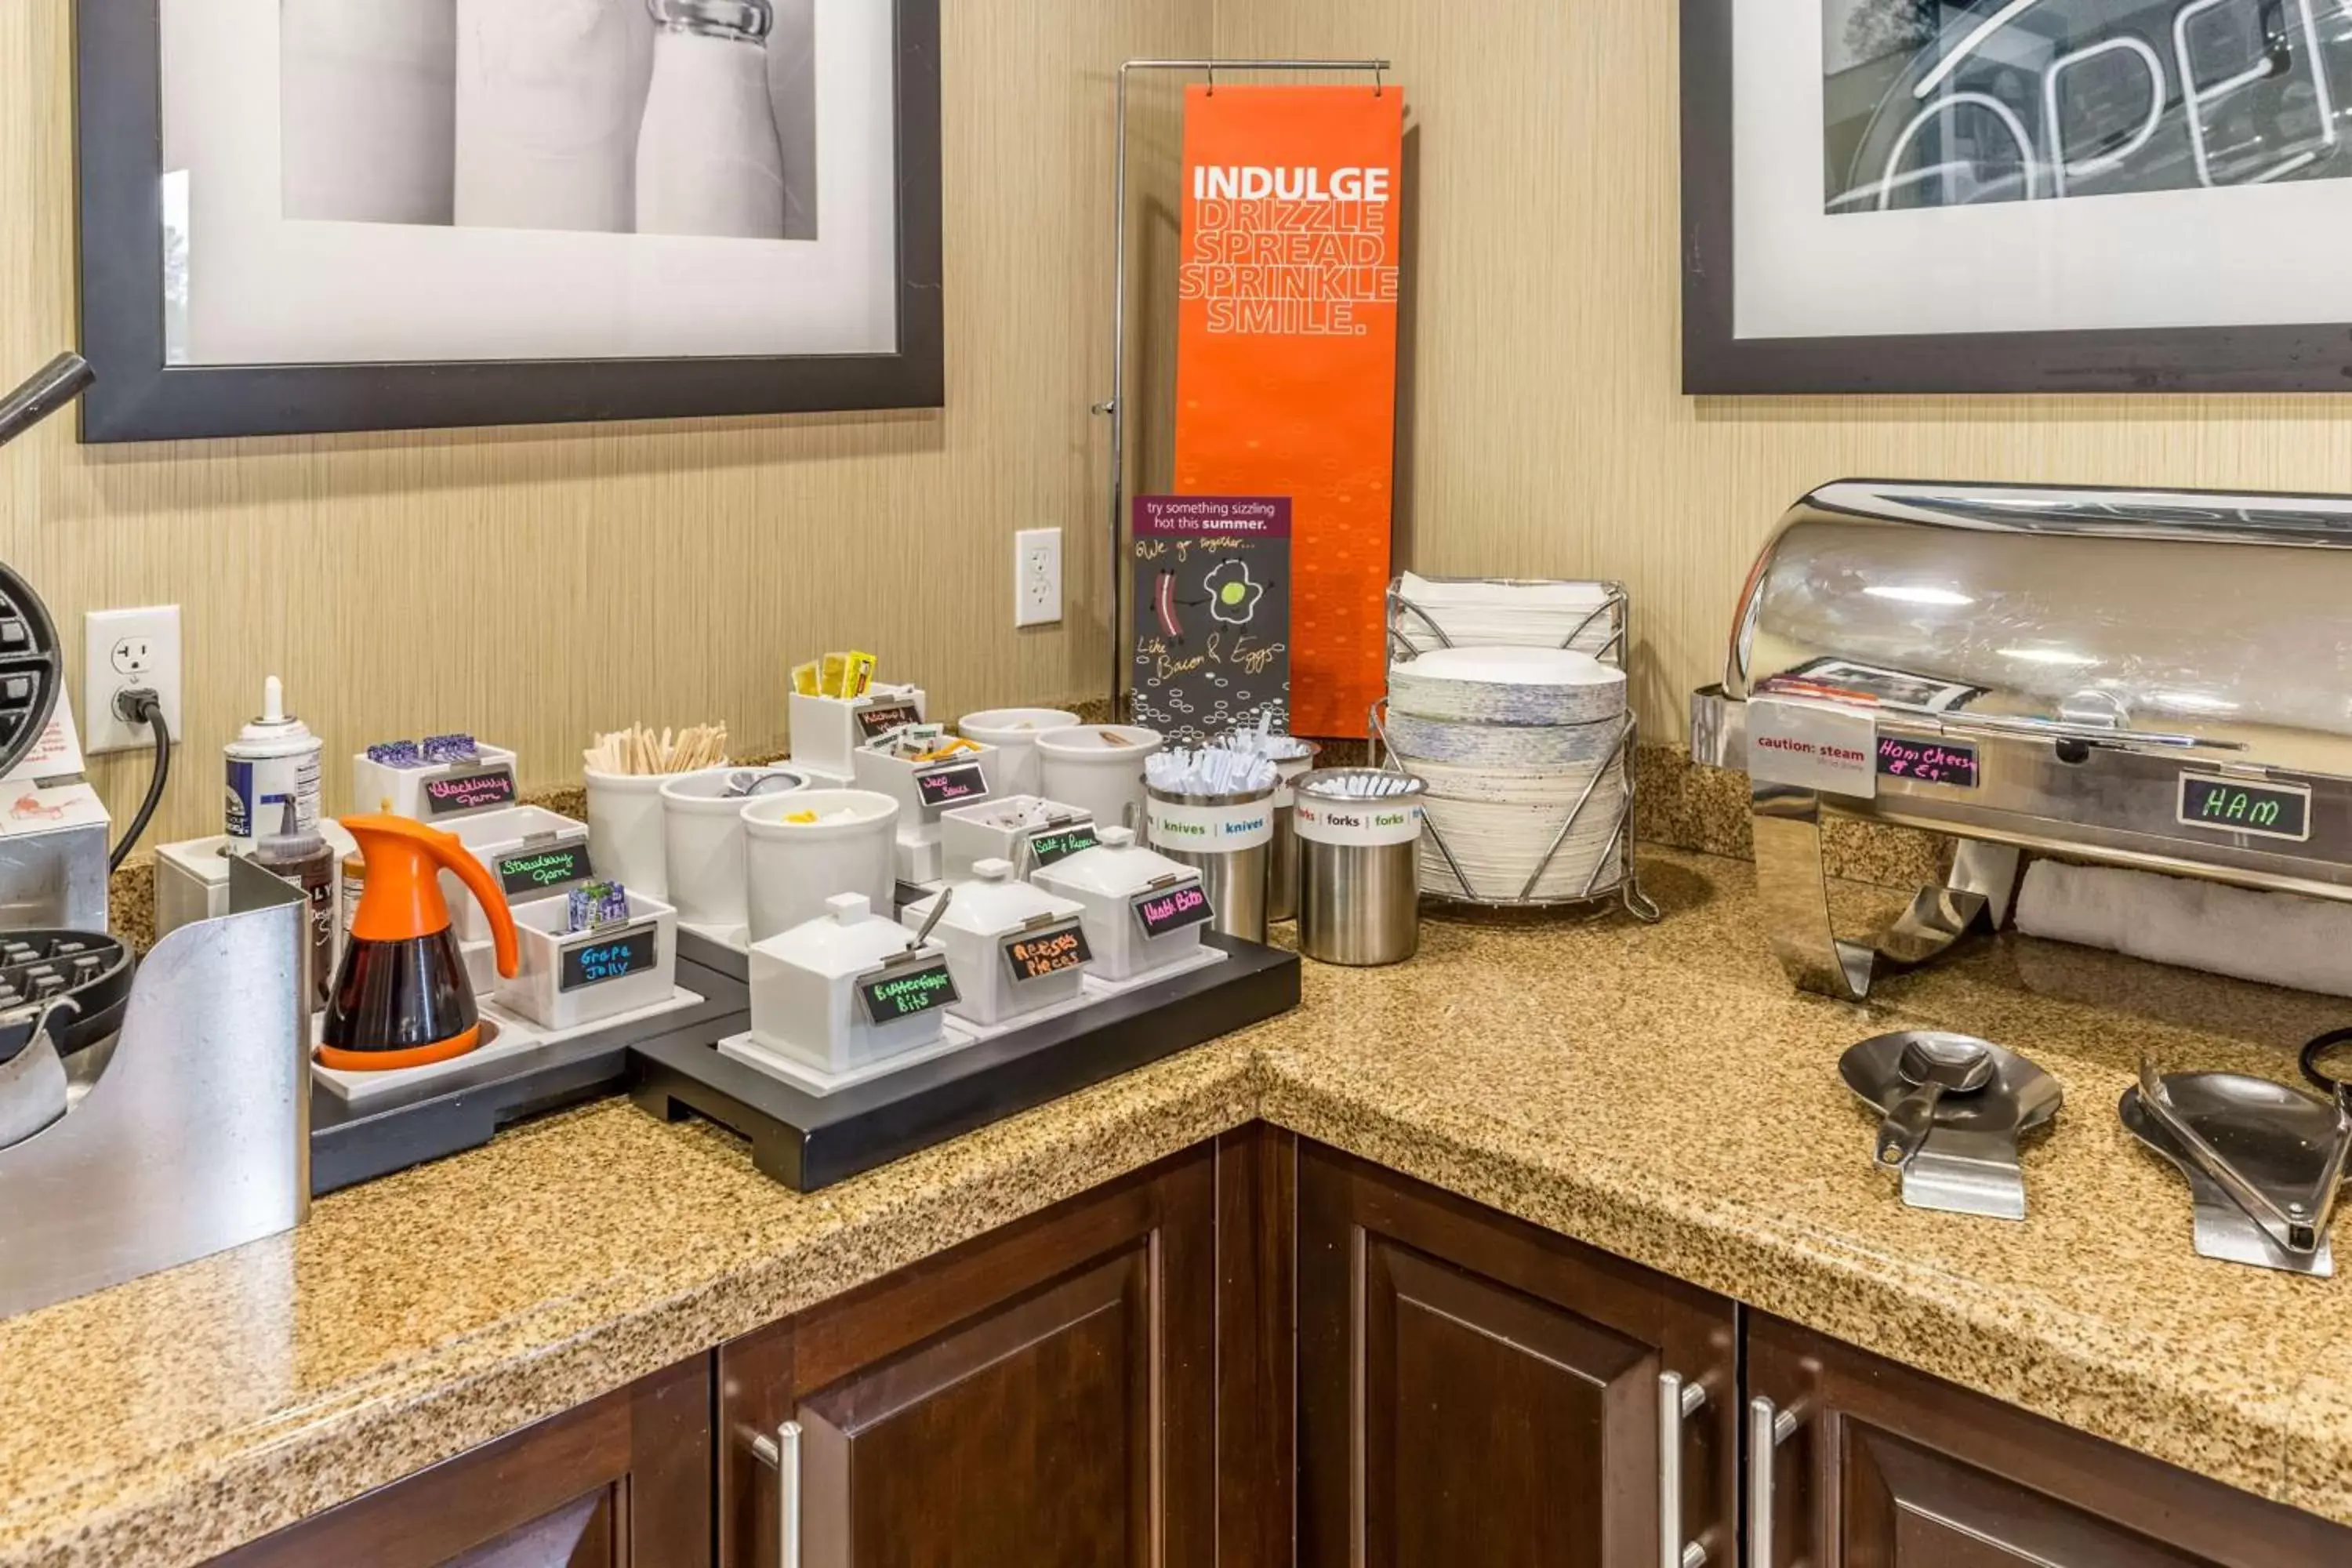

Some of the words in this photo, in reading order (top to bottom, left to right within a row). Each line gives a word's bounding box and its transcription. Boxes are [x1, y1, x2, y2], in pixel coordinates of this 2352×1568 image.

[1193, 165, 1389, 201] INDULGE
[1195, 198, 1386, 235] DRIZZLE
[1193, 230, 1385, 268] SPREAD
[1178, 263, 1399, 303] SPRINKLE
[1207, 296, 1367, 336] SMILE.
[1147, 503, 1162, 516] try
[1166, 502, 1229, 517] something
[1232, 502, 1276, 517] sizzling
[1155, 517, 1174, 529] hot
[1178, 517, 1200, 529] this
[1202, 519, 1267, 530] summer.
[1136, 539, 1167, 561] We
[1176, 539, 1192, 563] go
[1138, 636, 1167, 654] Like
[1156, 655, 1205, 680] Bacon
[1207, 632, 1221, 663] &
[1230, 634, 1273, 674] Eggs
[1757, 735, 1815, 753] caution:
[1820, 745, 1864, 762] steam
[1879, 739, 1919, 760] Ham
[2201, 788, 2280, 826] HAM
[1163, 819, 1206, 835] knives
[1225, 818, 1264, 833] knives
[1327, 813, 1360, 827] forks
[1375, 813, 1404, 826] forks
[580, 946, 633, 965] Grape
[896, 992, 929, 1013] Bits
